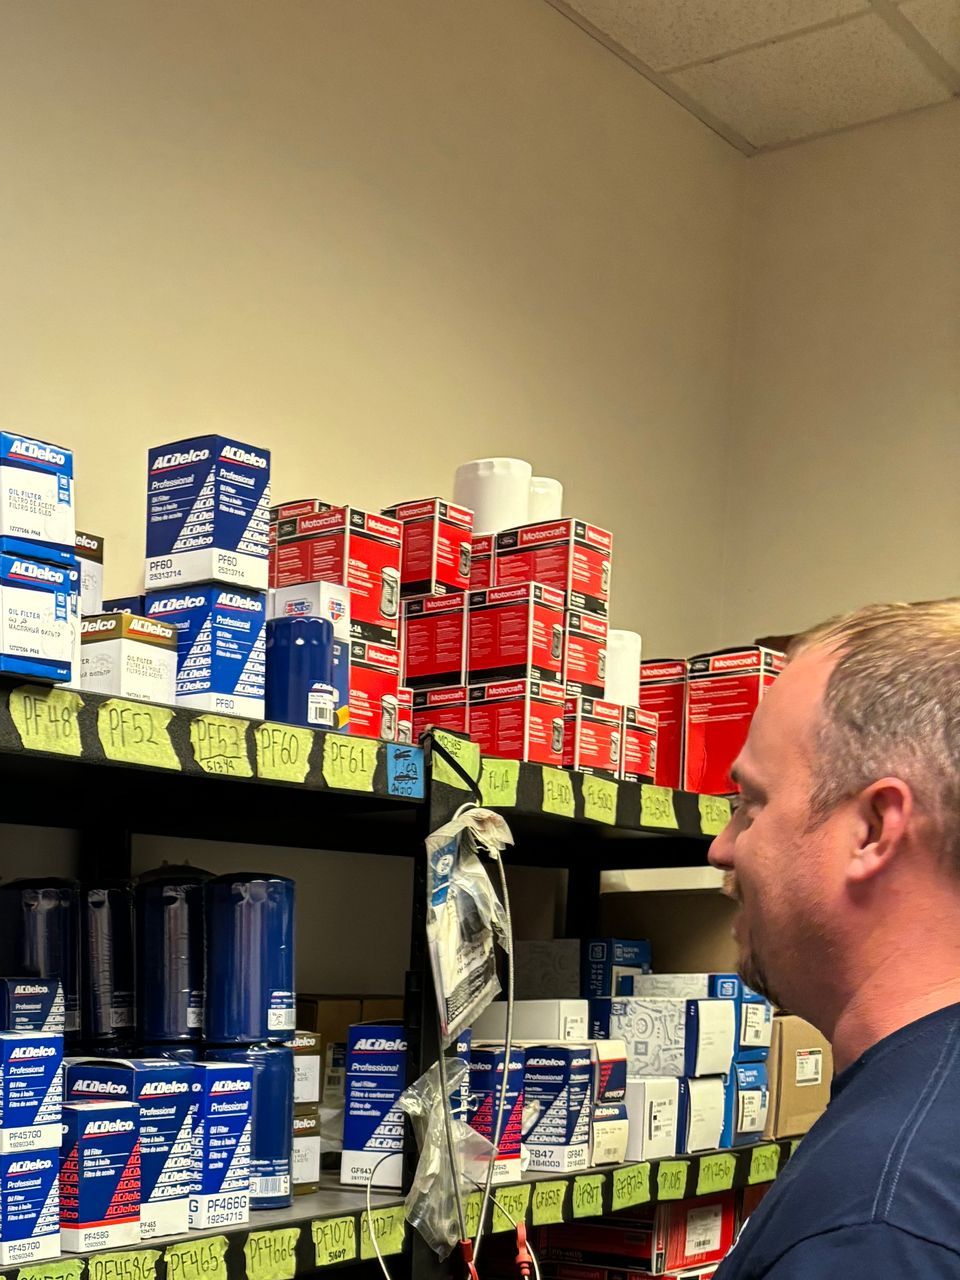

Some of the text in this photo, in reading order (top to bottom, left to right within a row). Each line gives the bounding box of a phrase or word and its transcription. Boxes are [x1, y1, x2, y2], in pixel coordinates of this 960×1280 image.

[10, 440, 65, 466] ACDelco
[152, 449, 209, 470] ACDelco
[221, 446, 267, 467] ACDelco
[152, 474, 194, 489] Professional
[219, 469, 255, 486] Professional
[399, 504, 433, 517] Motorcraft
[301, 514, 342, 530] Motorcraft
[368, 519, 399, 536] Motorcraft
[522, 528, 567, 541] Motorcraft
[150, 559, 173, 571] PF60
[218, 554, 237, 566] PF60
[10, 561, 64, 583] ACDelco
[491, 587, 527, 600] Motorcraft
[149, 596, 205, 613] ACDelco
[217, 593, 262, 611] ACDelco
[426, 597, 462, 611] Motorcraft
[129, 619, 173, 639] ACDelco
[216, 615, 251, 629] Professional
[368, 644, 398, 663] Motorcraft
[714, 653, 757, 669] Motorcraft
[642, 664, 682, 678] Motorcraft
[489, 684, 523, 695] Motorcraft
[216, 697, 234, 709] PF60
[23, 695, 72, 739] PF48
[109, 708, 158, 747] PF52
[197, 719, 240, 760] PF53
[262, 729, 299, 767] PF60
[332, 742, 367, 777] PF61
[355, 1039, 407, 1050] ACDelc
[9, 1065, 44, 1074] Professional
[351, 1063, 399, 1072] Professional
[140, 1107, 176, 1115] Professional
[211, 1102, 248, 1112] Professional
[208, 1196, 247, 1212] PF466G
[207, 1212, 243, 1224] 19254715
[315, 1219, 354, 1259] PF1070
[249, 1233, 297, 1273] PF466G
